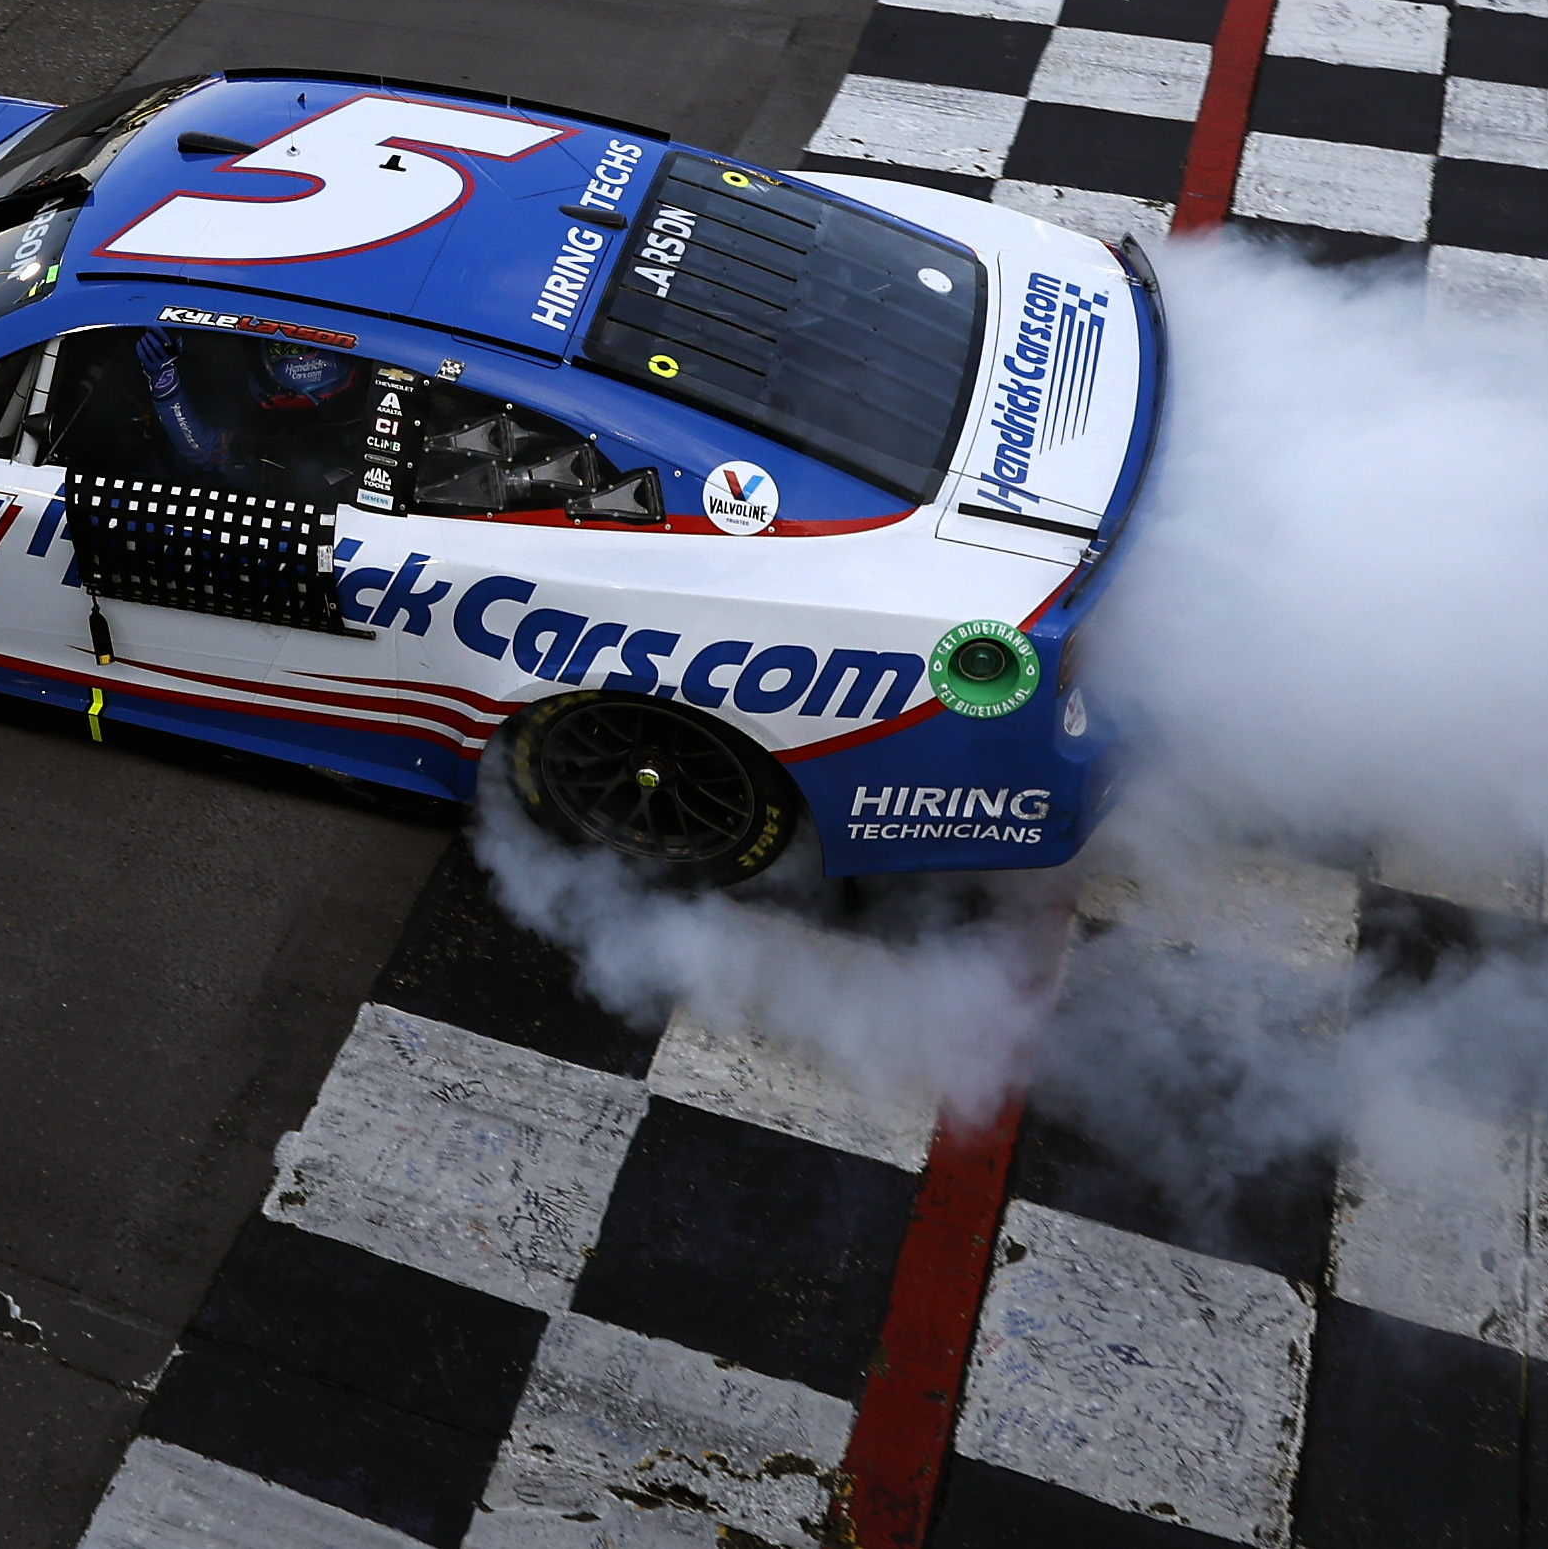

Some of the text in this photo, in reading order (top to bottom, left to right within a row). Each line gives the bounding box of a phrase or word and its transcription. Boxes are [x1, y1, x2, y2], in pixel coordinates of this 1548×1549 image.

[92, 93, 581, 266] 5
[7, 197, 64, 281] ARSON
[530, 138, 643, 332] HIRING TECHS
[633, 203, 699, 299] LARSON
[154, 367, 176, 390] 5
[374, 379, 414, 393] CHEVROLET
[375, 417, 400, 436] CI
[363, 467, 392, 486] MAC
[363, 479, 392, 491] TOOLS
[709, 495, 769, 524] VALVOLINE
[937, 621, 1033, 663] GET BIOETHANOL
[955, 687, 1032, 717] BIOETHANOL
[851, 785, 1051, 821] HIRING
[738, 804, 781, 867] EAGLE
[847, 823, 1042, 844] TECHNICIANS
